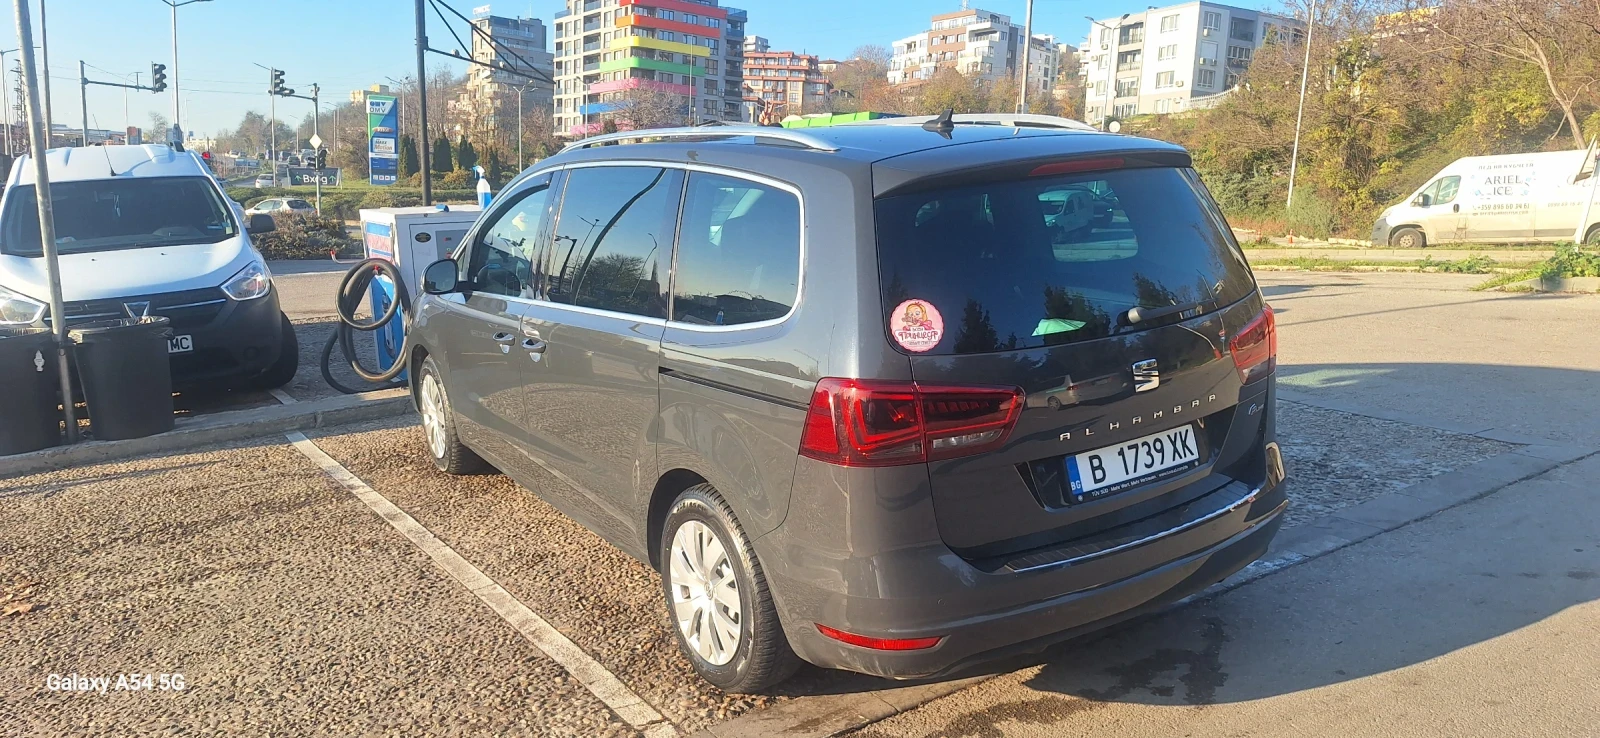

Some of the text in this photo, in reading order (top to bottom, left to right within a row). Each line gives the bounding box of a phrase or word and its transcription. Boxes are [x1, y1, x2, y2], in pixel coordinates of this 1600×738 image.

[1484, 174, 1522, 185] ARIEL
[1493, 186, 1512, 196] ICE
[169, 337, 190, 351] MC
[1059, 394, 1217, 442] ALHAMBRA
[1088, 429, 1195, 484] B 1739 XK
[1070, 480, 1081, 491] BG
